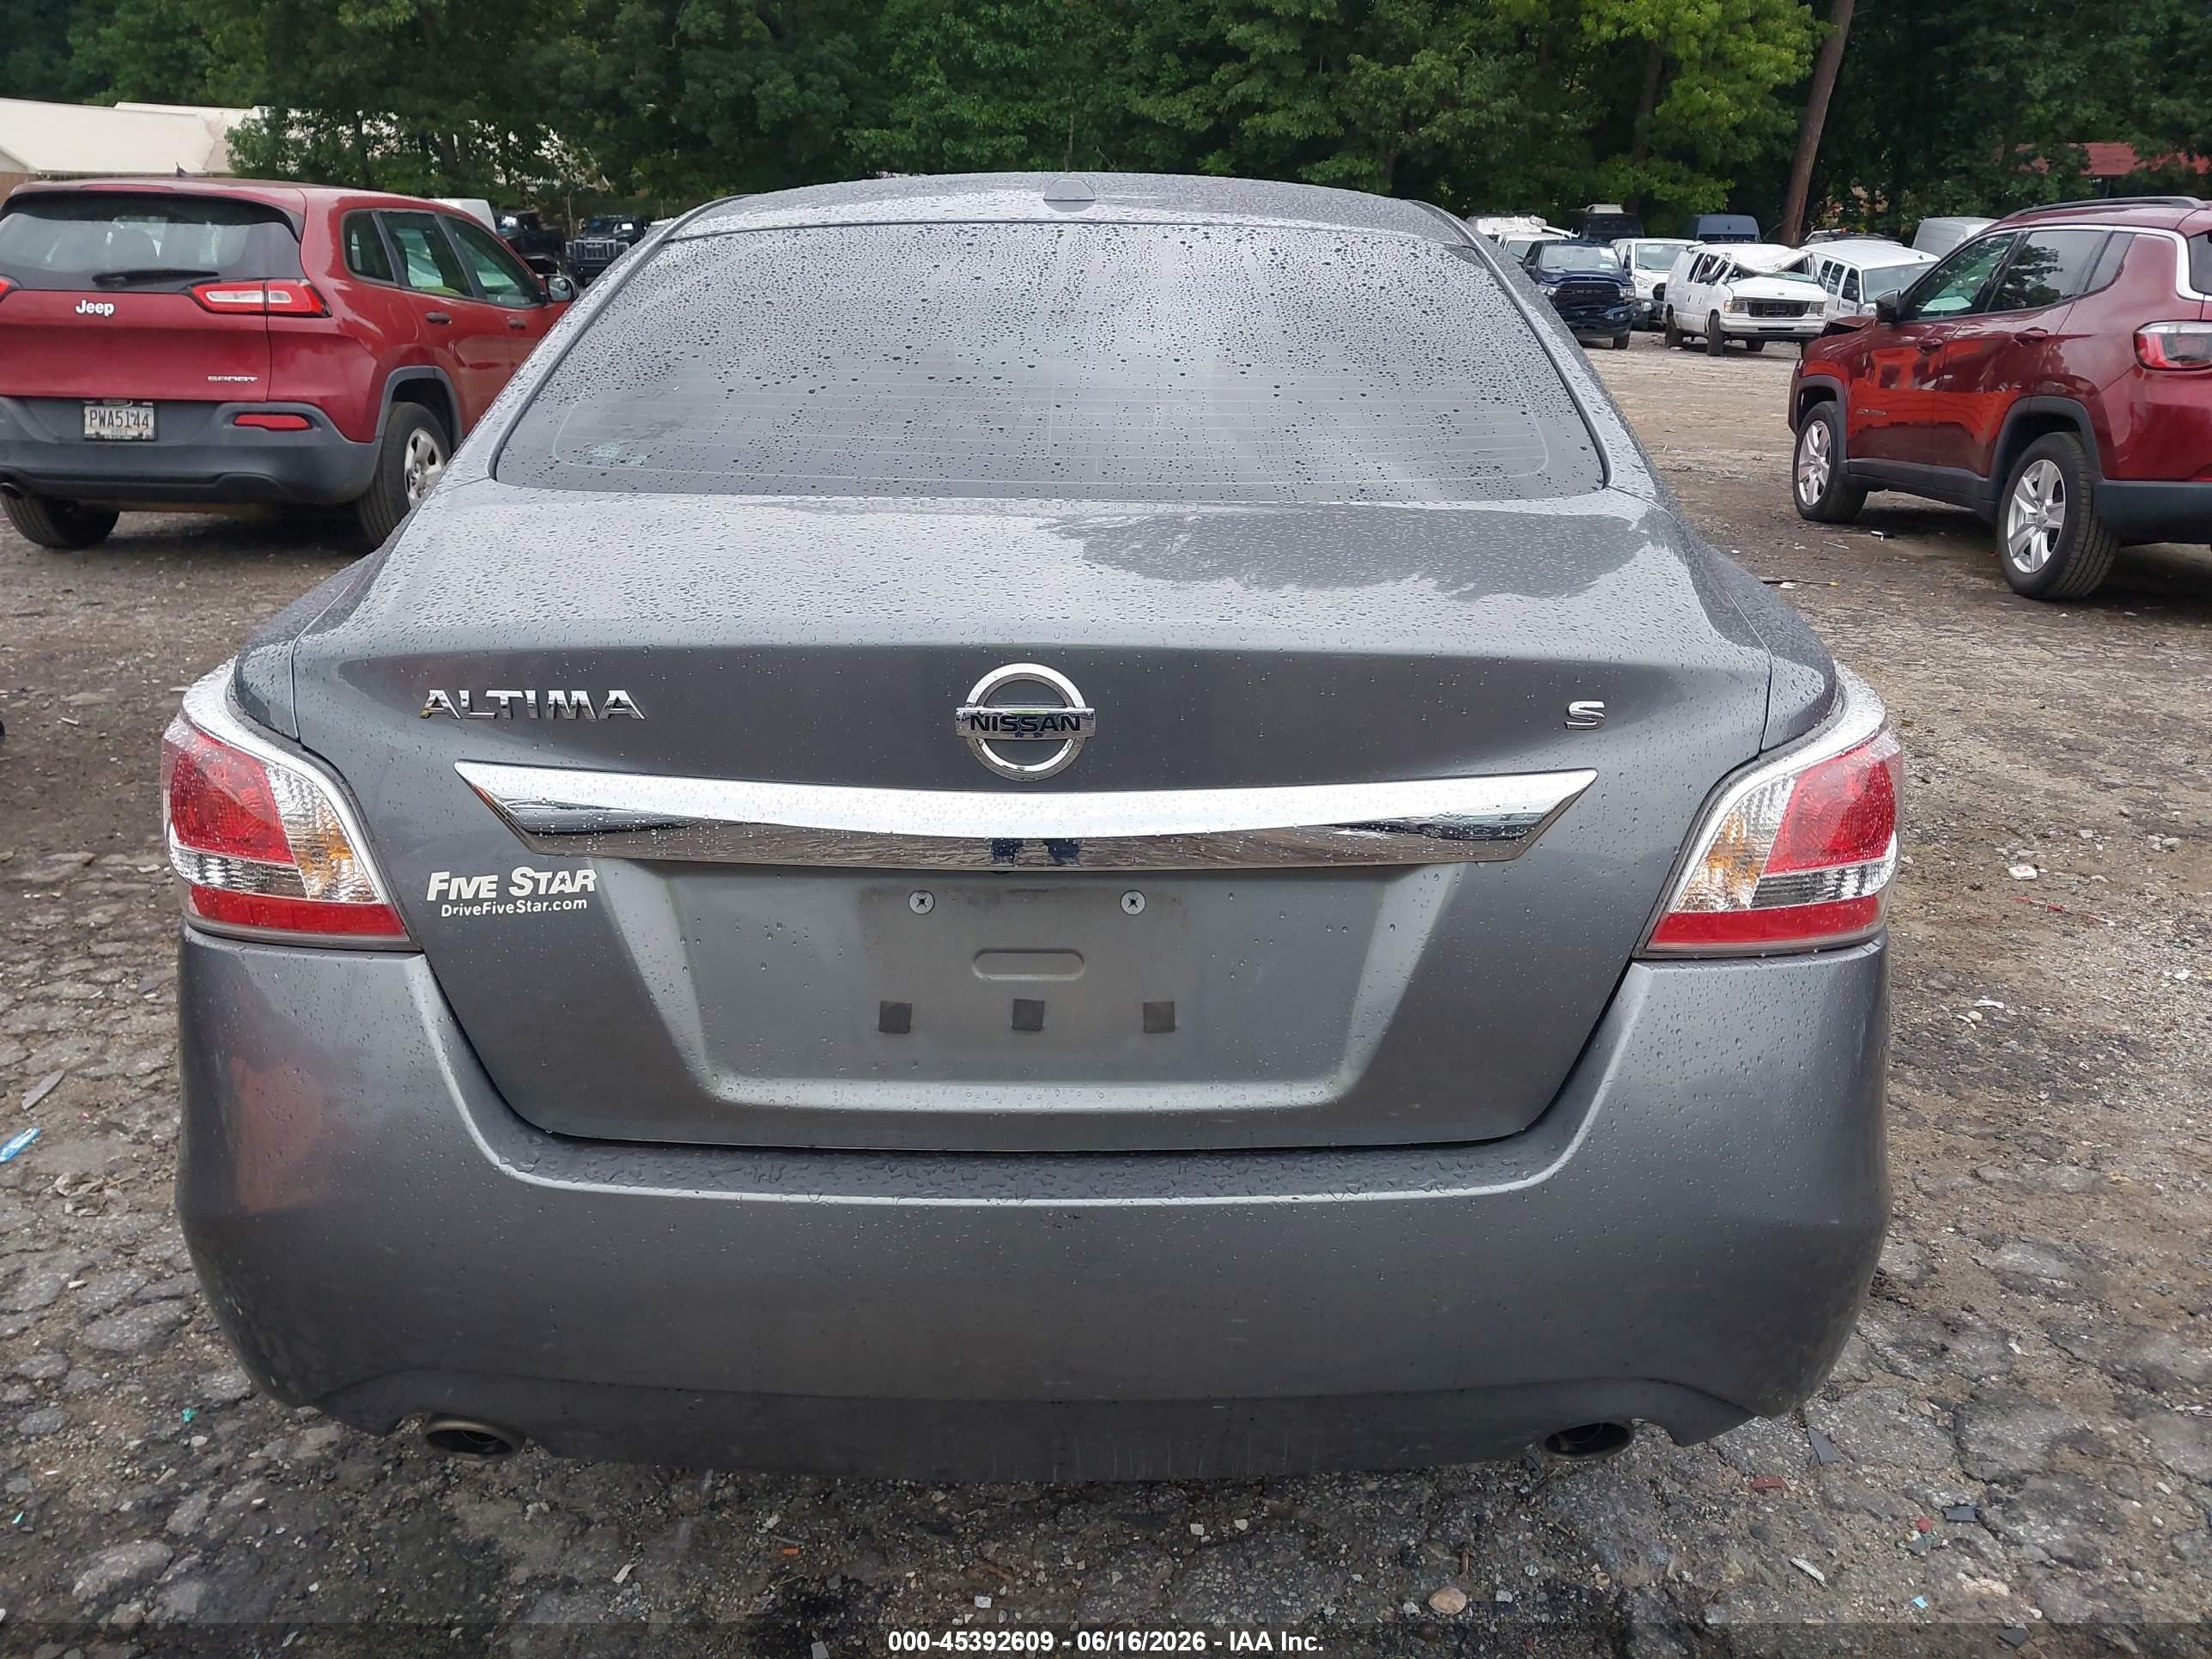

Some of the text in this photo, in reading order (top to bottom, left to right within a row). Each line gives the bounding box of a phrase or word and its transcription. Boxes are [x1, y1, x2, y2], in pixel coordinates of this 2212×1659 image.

[76, 300, 114, 317] Jeep
[89, 410, 149, 429] PWA5144
[419, 689, 646, 720] ALTIMA
[969, 714, 1081, 732] NISSAN
[1565, 701, 1606, 730] S
[427, 866, 598, 902] FIVE STAR
[441, 899, 588, 918] DriveFiveStar.com
